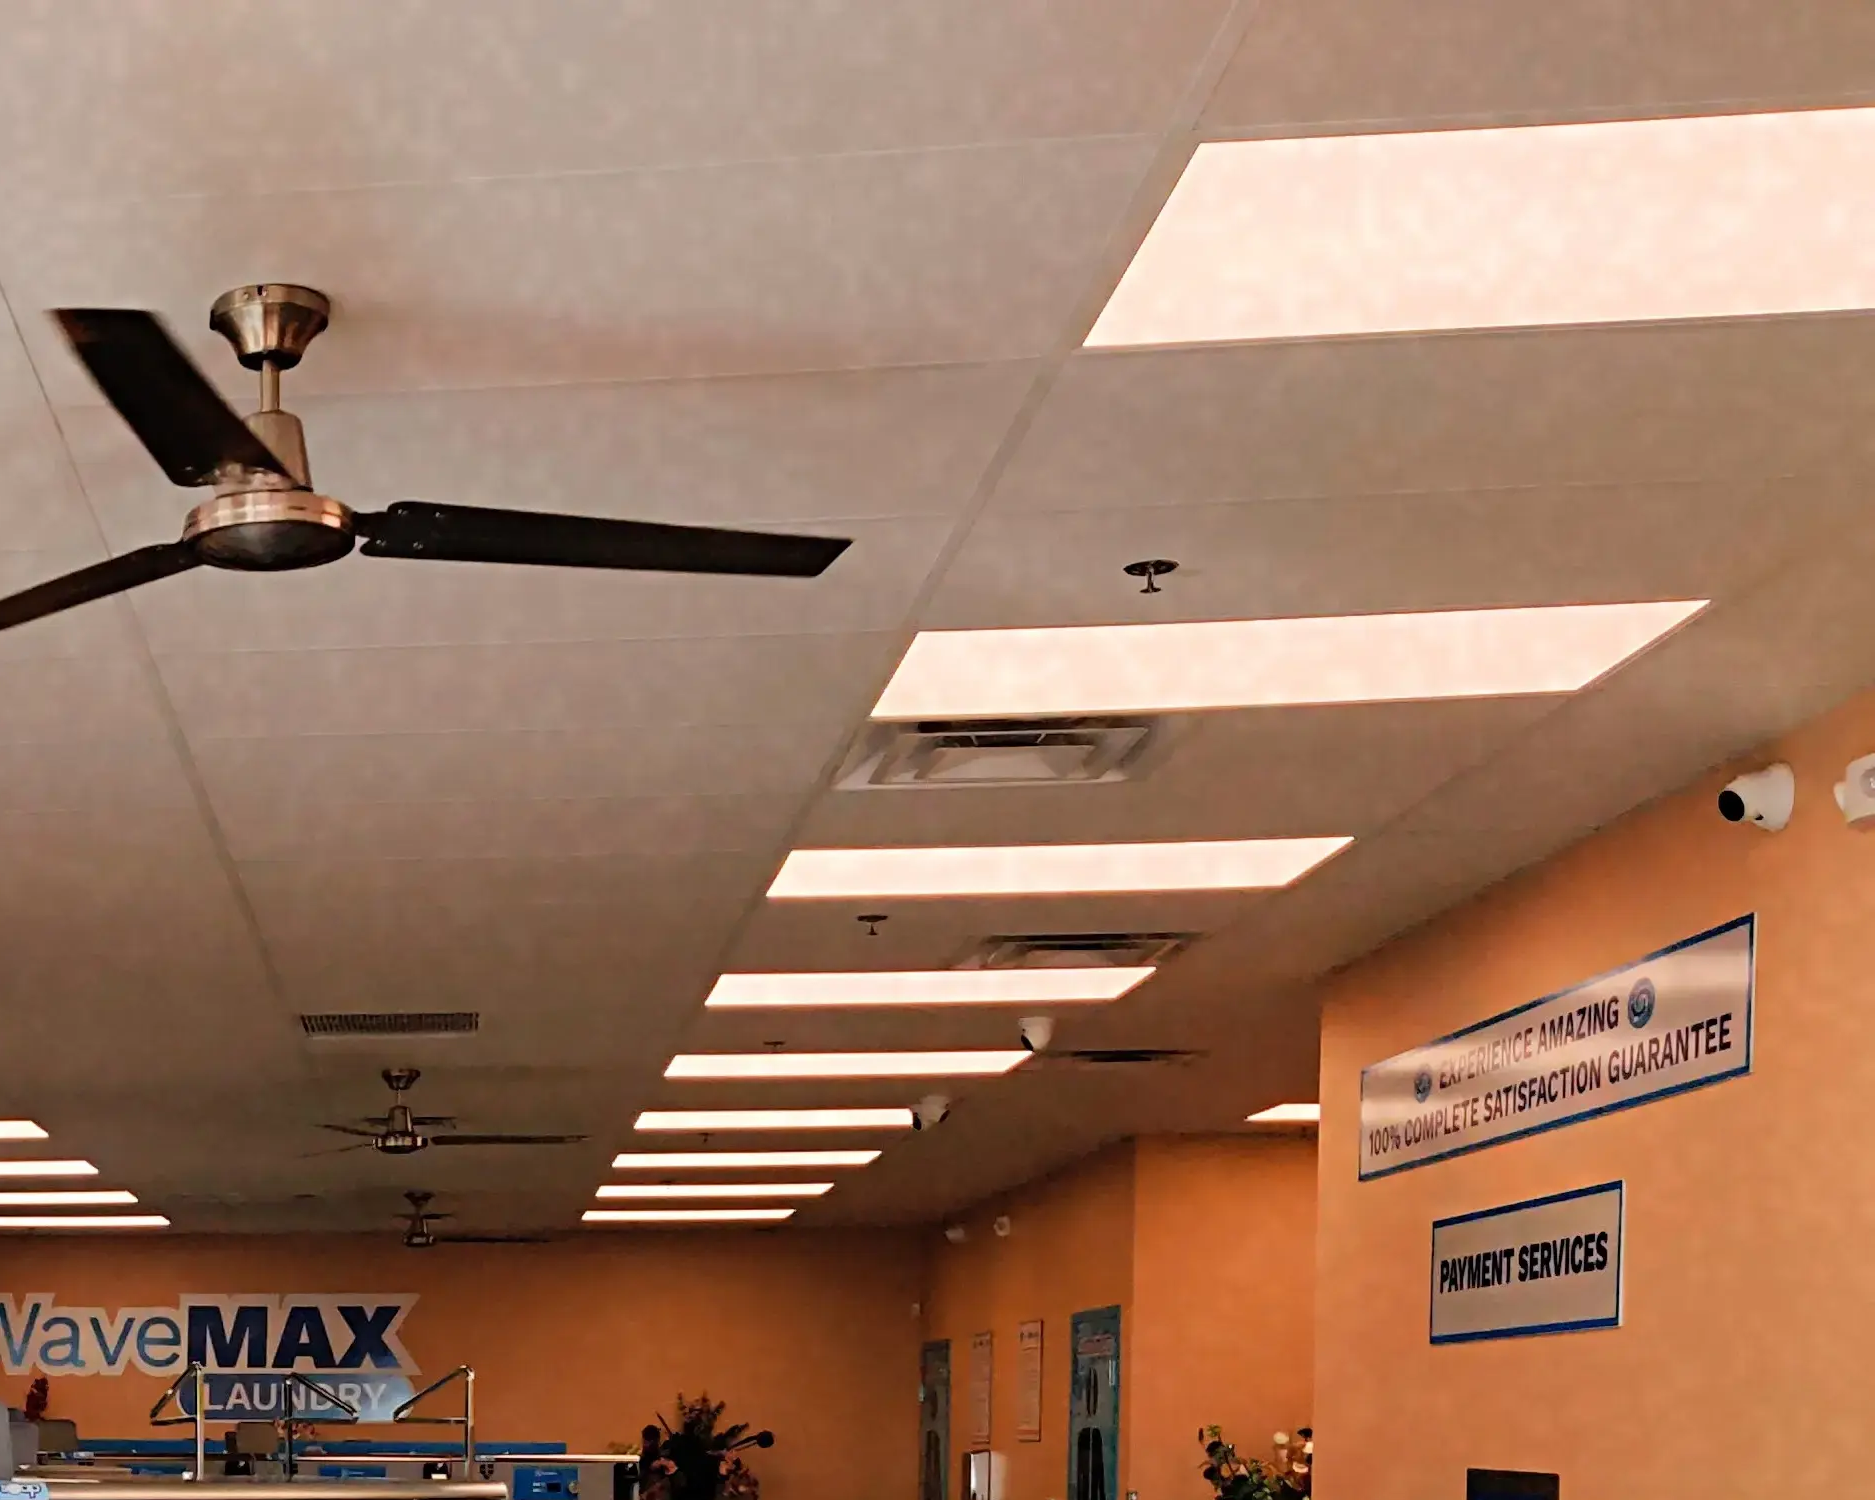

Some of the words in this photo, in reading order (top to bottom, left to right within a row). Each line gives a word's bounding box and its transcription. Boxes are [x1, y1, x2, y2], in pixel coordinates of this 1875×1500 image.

[1439, 1027, 1533, 1089] EXPERIENCE
[1537, 996, 1620, 1055] AMAZING
[1369, 1124, 1401, 1157] 100%
[1404, 1097, 1479, 1147] COMPLETE
[1484, 1056, 1602, 1123] SATISFACTION
[1608, 1013, 1733, 1085] GUARANTEE
[1440, 1248, 1515, 1294] PAYMENT
[1518, 1231, 1608, 1282] SERVICES
[203, 1383, 387, 1411] LAUNDRY
